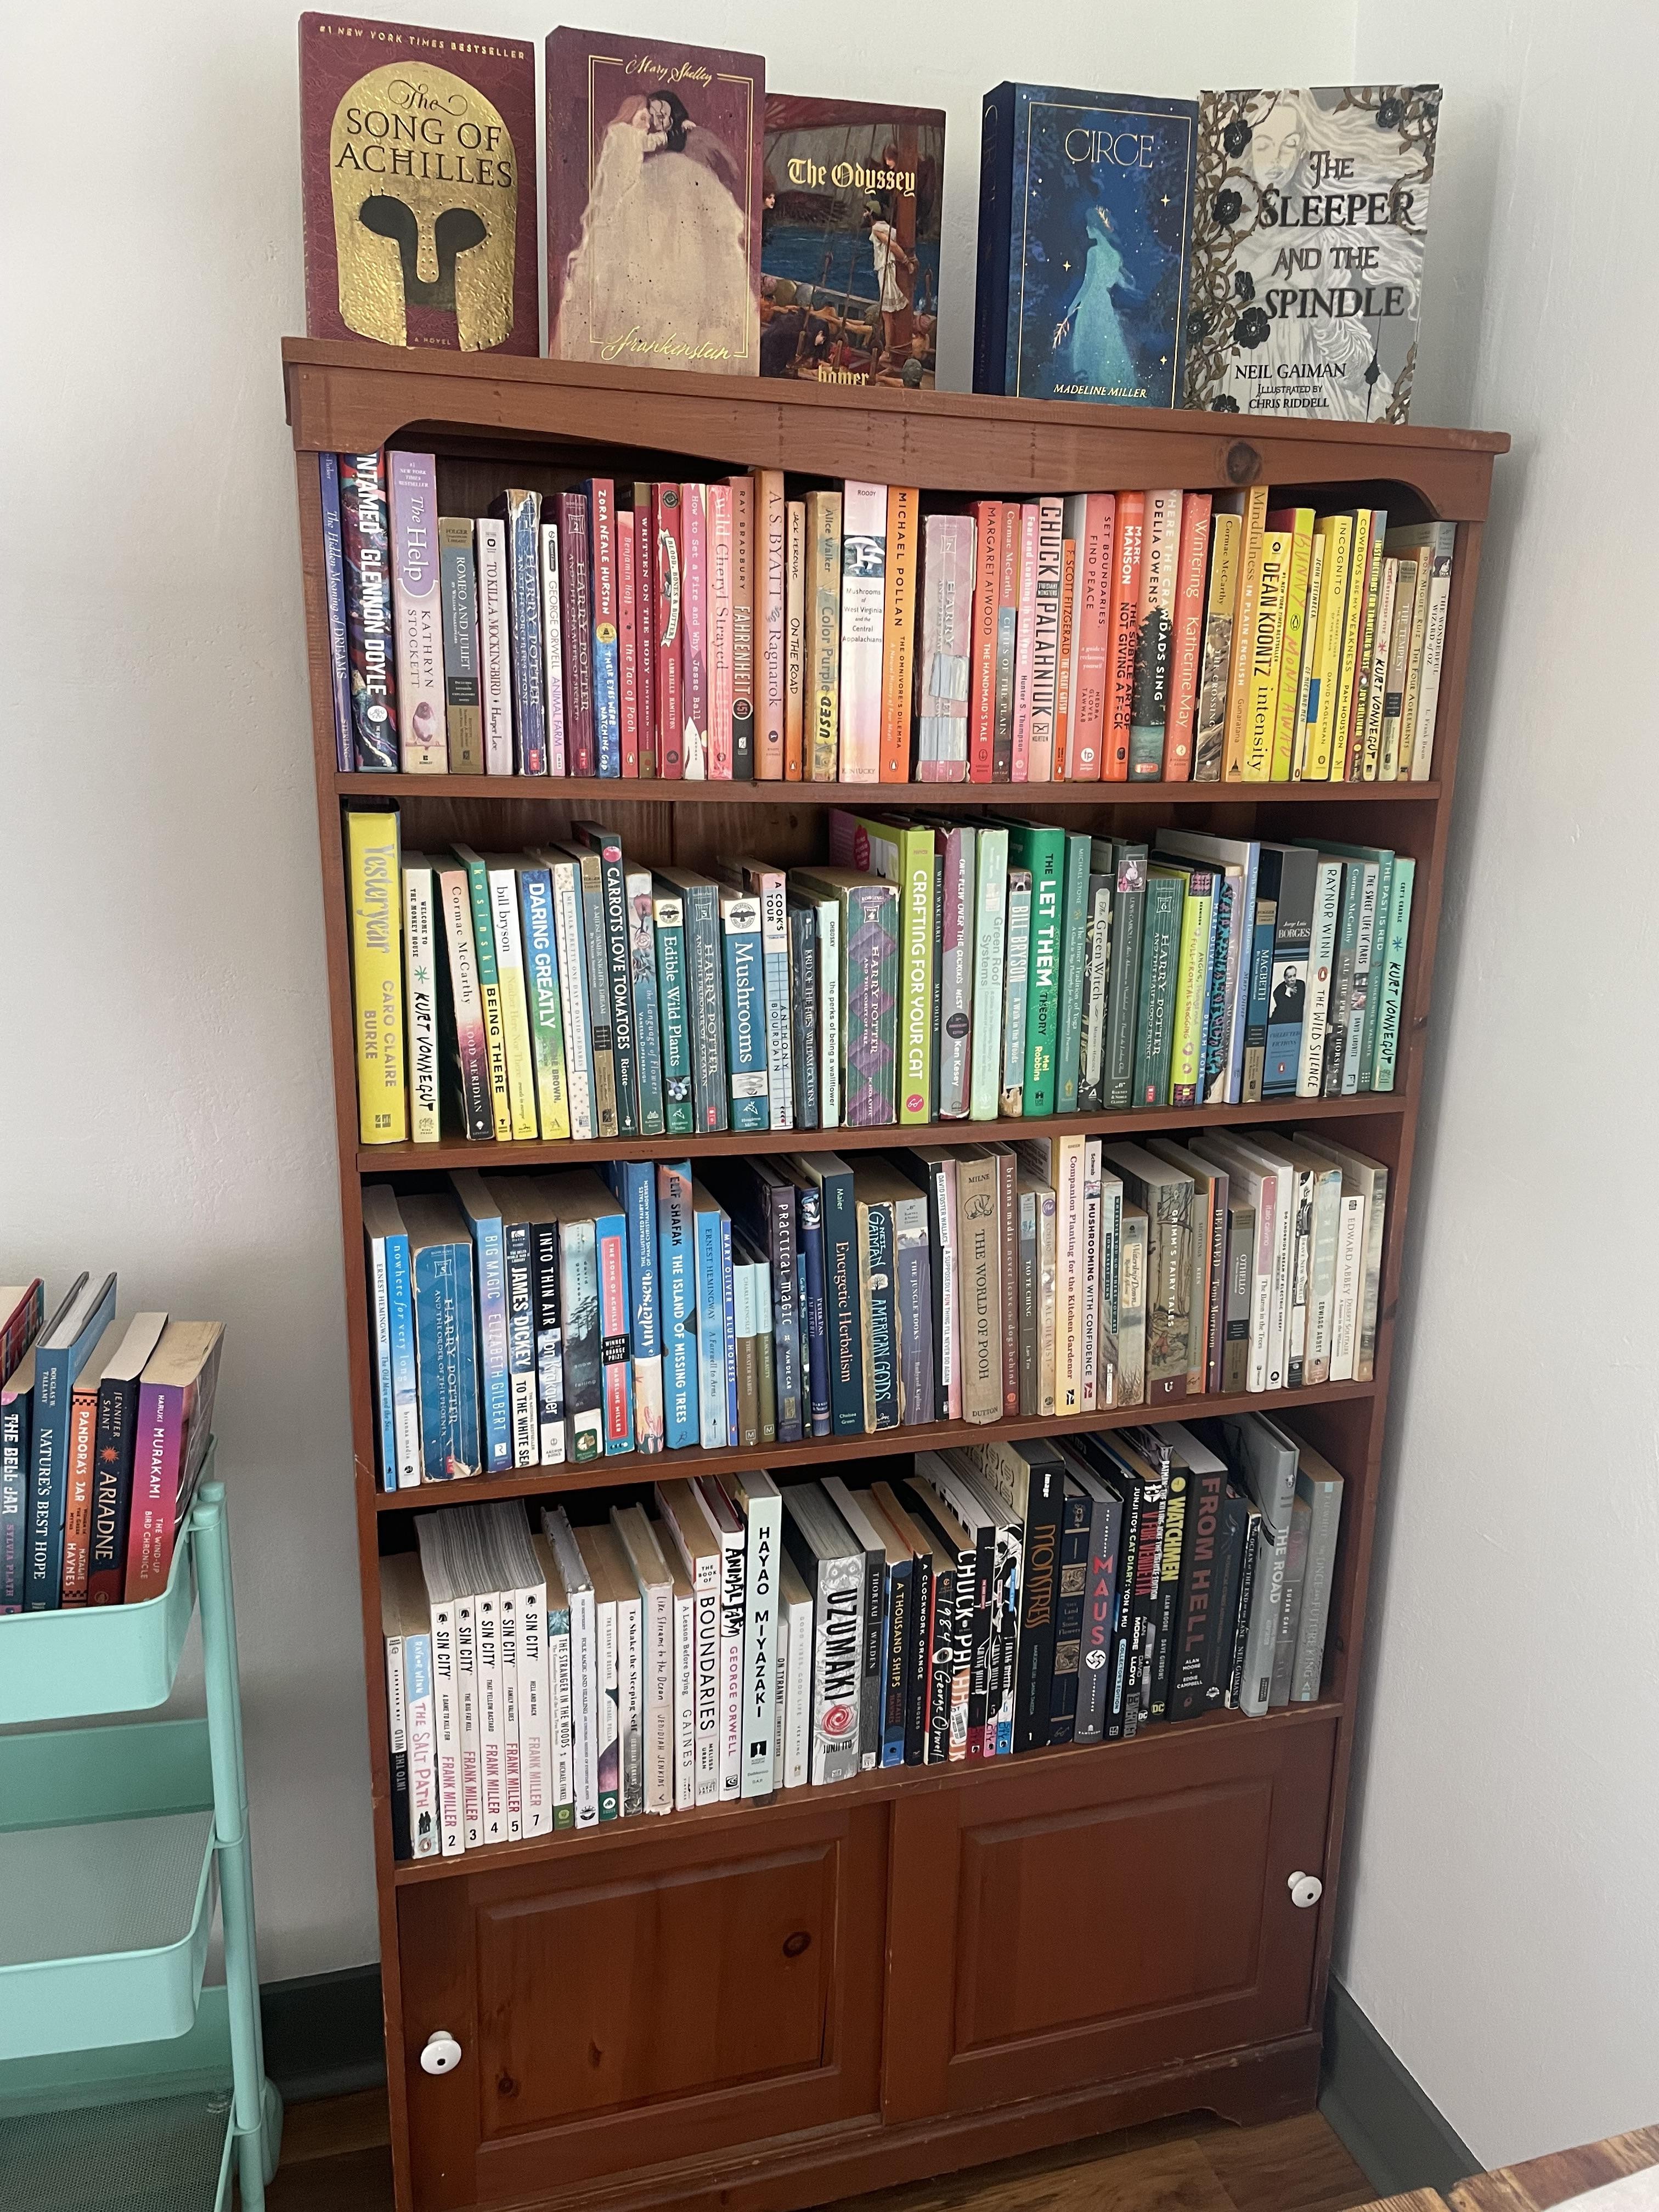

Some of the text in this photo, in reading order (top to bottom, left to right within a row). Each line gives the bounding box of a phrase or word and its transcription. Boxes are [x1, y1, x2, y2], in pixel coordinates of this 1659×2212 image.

[338, 27, 364, 38] NEW
[370, 31, 403, 43] YORK
[409, 36, 445, 48] TIMES
[451, 41, 526, 60] BESTSELLER
[624, 55, 713, 87] Mary Shelley
[347, 109, 501, 152] SONG OF
[388, 80, 468, 116] The
[335, 144, 512, 189] ACHILLES
[787, 159, 916, 197] The Odyssey
[1065, 129, 1154, 168] CIRCE
[1309, 151, 1354, 189] THE
[1259, 189, 1416, 229] SLEEPER
[1272, 246, 1379, 281] AND THE
[1264, 286, 1405, 320] SPINDLE
[424, 337, 451, 345] NOVEL
[601, 326, 732, 360] Frankenstein
[1234, 363, 1346, 380] NEIL GAIMAN
[1054, 383, 1147, 398] MADELINE MILLER
[1249, 397, 1329, 409] CHRIS RIDDELL
[1312, 385, 1323, 394] BY
[403, 496, 428, 582] The Help
[597, 489, 611, 616] ZORA NEALE HURSTON
[894, 492, 907, 627] MICHAEL POLLAN
[1039, 506, 1062, 577] CHUCK
[1149, 500, 1164, 603] DELIA OWENS
[1186, 518, 1208, 599] Wintering
[1334, 523, 1346, 595] INCOGNITO
[359, 549, 387, 697] GLENNON DOYLE
[407, 609, 420, 689] STOCKETT
[421, 610, 435, 689] KATHRYN
[733, 605, 751, 695] FAHRENHEIT
[1254, 562, 1281, 677] DEAN KOONTZ
[549, 580, 563, 747] GEORGE ORWELL ANIMAL FARM
[1031, 602, 1059, 716] PALAHNIUK
[737, 701, 747, 714] 451
[820, 697, 831, 738] USED
[358, 843, 395, 953] Yesteryear
[496, 886, 511, 952] bill bryson
[1320, 869, 1337, 958] RAYNOR WINN
[606, 867, 630, 1086] CARROTS LOVE TOMATOES Riotte
[908, 870, 927, 1080] CRAFTING FOR YOUR CAT
[1035, 853, 1056, 1035] THE LET THEM THEORY
[364, 1011, 377, 1059] BURKE
[382, 980, 397, 1088] CARO CLAIRE
[663, 935, 681, 1067] Edible Wild Plants
[735, 941, 755, 1063] Mushrooms
[414, 992, 436, 1111] KURT VONNEGUT
[485, 988, 505, 1093] BEING THERE
[968, 1173, 990, 1184] MILNE
[539, 1232, 555, 1325] INTO THIN AIR
[1087, 1203, 1096, 1282] MUSHROOMING
[511, 1267, 532, 1366] JAMES DICKEY
[669, 1176, 687, 1424] ELIF SHAFAK THE ISLAND OF MISSING TREES
[834, 1241, 854, 1383] Energetic Herbalism
[974, 1228, 989, 1380] THE WORLD OF POOH
[871, 1299, 891, 1402] AMERICAN GODS
[1085, 1314, 1093, 1376] CONFIDENCE
[972, 1407, 998, 1417] DUTTON
[2, 1413, 19, 1515] THE BELL JAR
[75, 1411, 89, 1502] PANDORA'S JAR
[149, 1427, 164, 1498] MURAKAMI
[33, 1428, 53, 1580] NATURE'S BEST HOPE
[94, 1471, 117, 1561] ARIADNE
[1161, 1496, 1186, 1581] WATCHMEN
[1184, 1476, 1221, 1652] FROM HELL
[1270, 1526, 1289, 1604] THE ROAD
[437, 1632, 450, 1678] SIN CITY
[459, 1627, 472, 1673] SIN CITY
[482, 1620, 494, 1666] SIN CITY
[503, 1620, 515, 1664] SIN CITY
[526, 1613, 538, 1659] SIN CITY
[755, 1527, 770, 1718] HAYAO MIYAZAKI
[825, 1588, 857, 1701] UZUMAKI
[893, 1593, 903, 1654] THOUSAND
[699, 1596, 715, 1731] BOUNDARIES
[728, 1646, 738, 1756] GEORGE ORWELL
[891, 1656, 900, 1688] SHIPS
[412, 1703, 431, 1808] THE SALT PATH
[442, 1756, 457, 1827] FRANK MILLER
[464, 1751, 478, 1822] FRANK MILLER
[448, 1836, 456, 1847] 2
[469, 1830, 477, 1841] 3
[490, 1822, 498, 1833] 4
[511, 1821, 518, 1832] 5
[533, 1815, 539, 1826] 7
